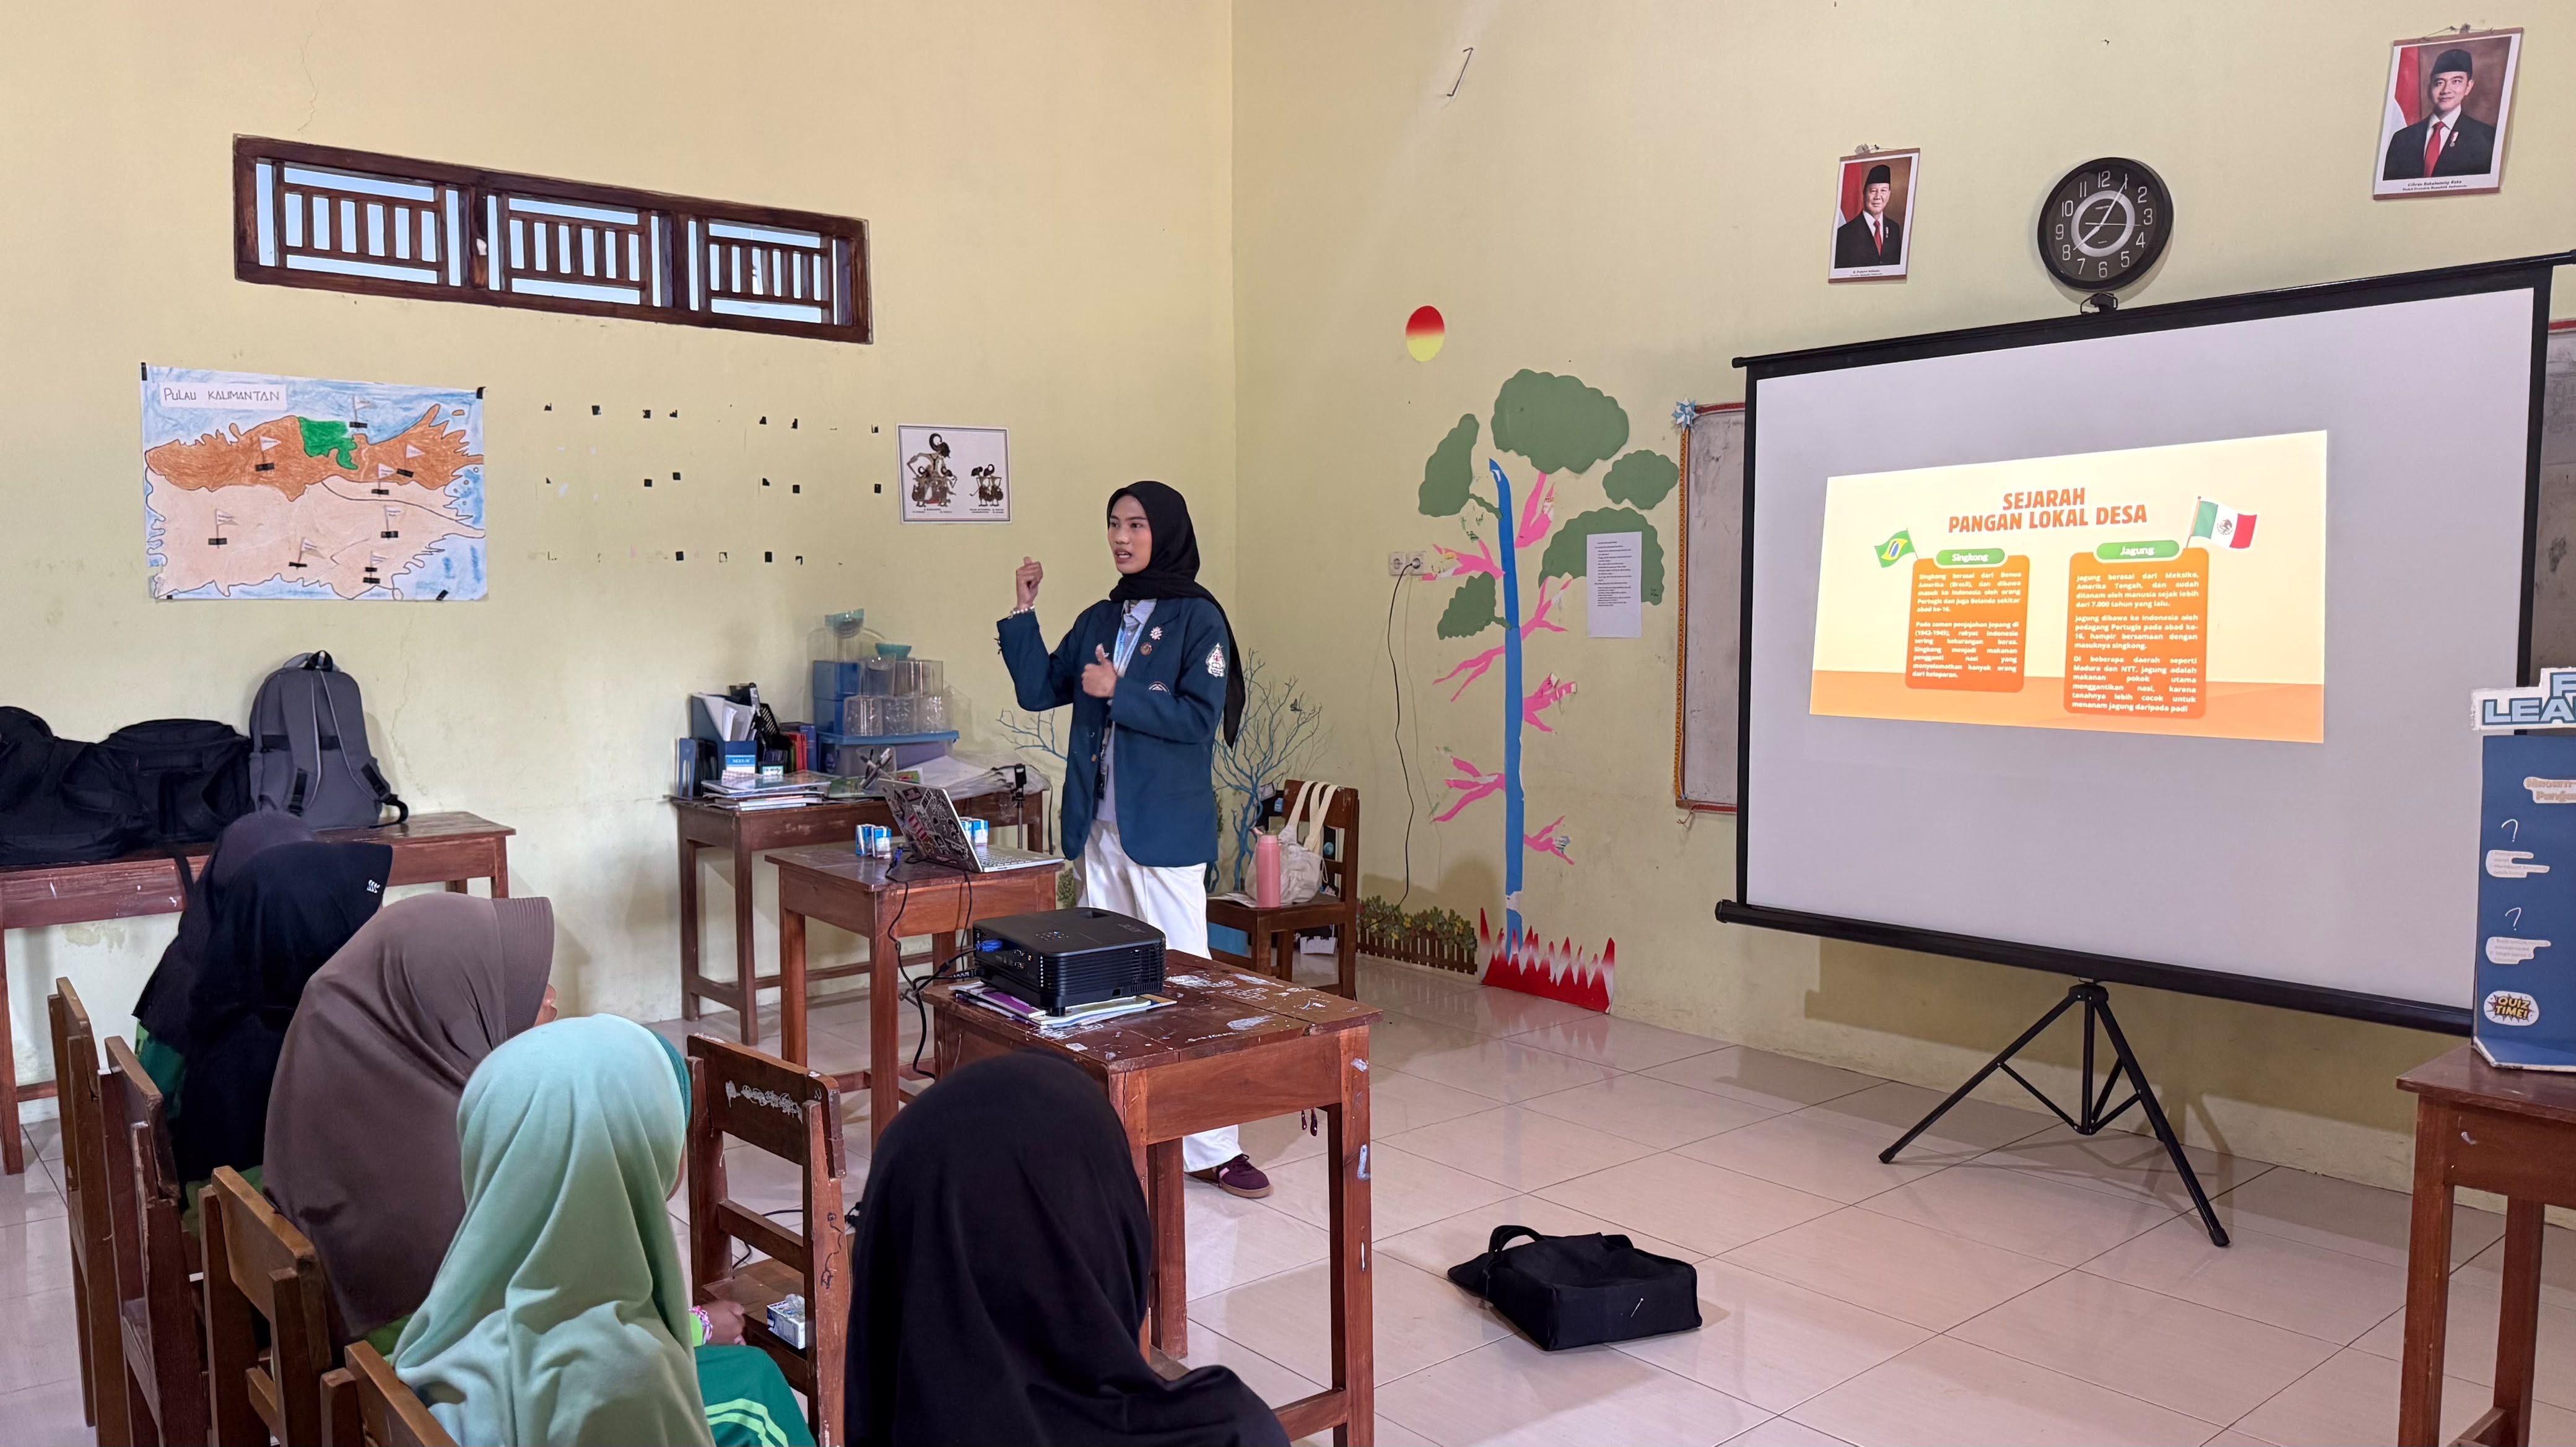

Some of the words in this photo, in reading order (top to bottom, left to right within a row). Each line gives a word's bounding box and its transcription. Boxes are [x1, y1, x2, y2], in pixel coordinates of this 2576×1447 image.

[2098, 171, 2110, 188] 12
[2138, 186, 2147, 203] 2
[2062, 201, 2073, 217] 10
[2144, 208, 2152, 225] 3
[2056, 224, 2064, 240] 9
[2136, 232, 2145, 248] 4
[2063, 245, 2071, 260] 8
[2121, 251, 2130, 267] 5
[2077, 258, 2086, 274] 7
[2099, 261, 2107, 278] 6
[208, 390, 279, 401] KALIMANTAN
[2003, 487, 2086, 510] SEJARAH
[1948, 513, 2022, 533] PANGAN
[2029, 509, 2088, 528] LOKAL
[2095, 505, 2147, 526] DESA
[1952, 553, 1988, 562] Singkong
[2120, 546, 2154, 556] Jagung
[2076, 574, 2100, 582] Jagung
[2091, 656, 2124, 664] beberapa
[2141, 666, 2167, 674] jagung
[2108, 702, 2134, 711] jagung
[2135, 703, 2169, 712] daripada
[2170, 705, 2188, 713] padi
[2497, 996, 2531, 1010] QUIZ
[2496, 1006, 2528, 1020] TIME!
